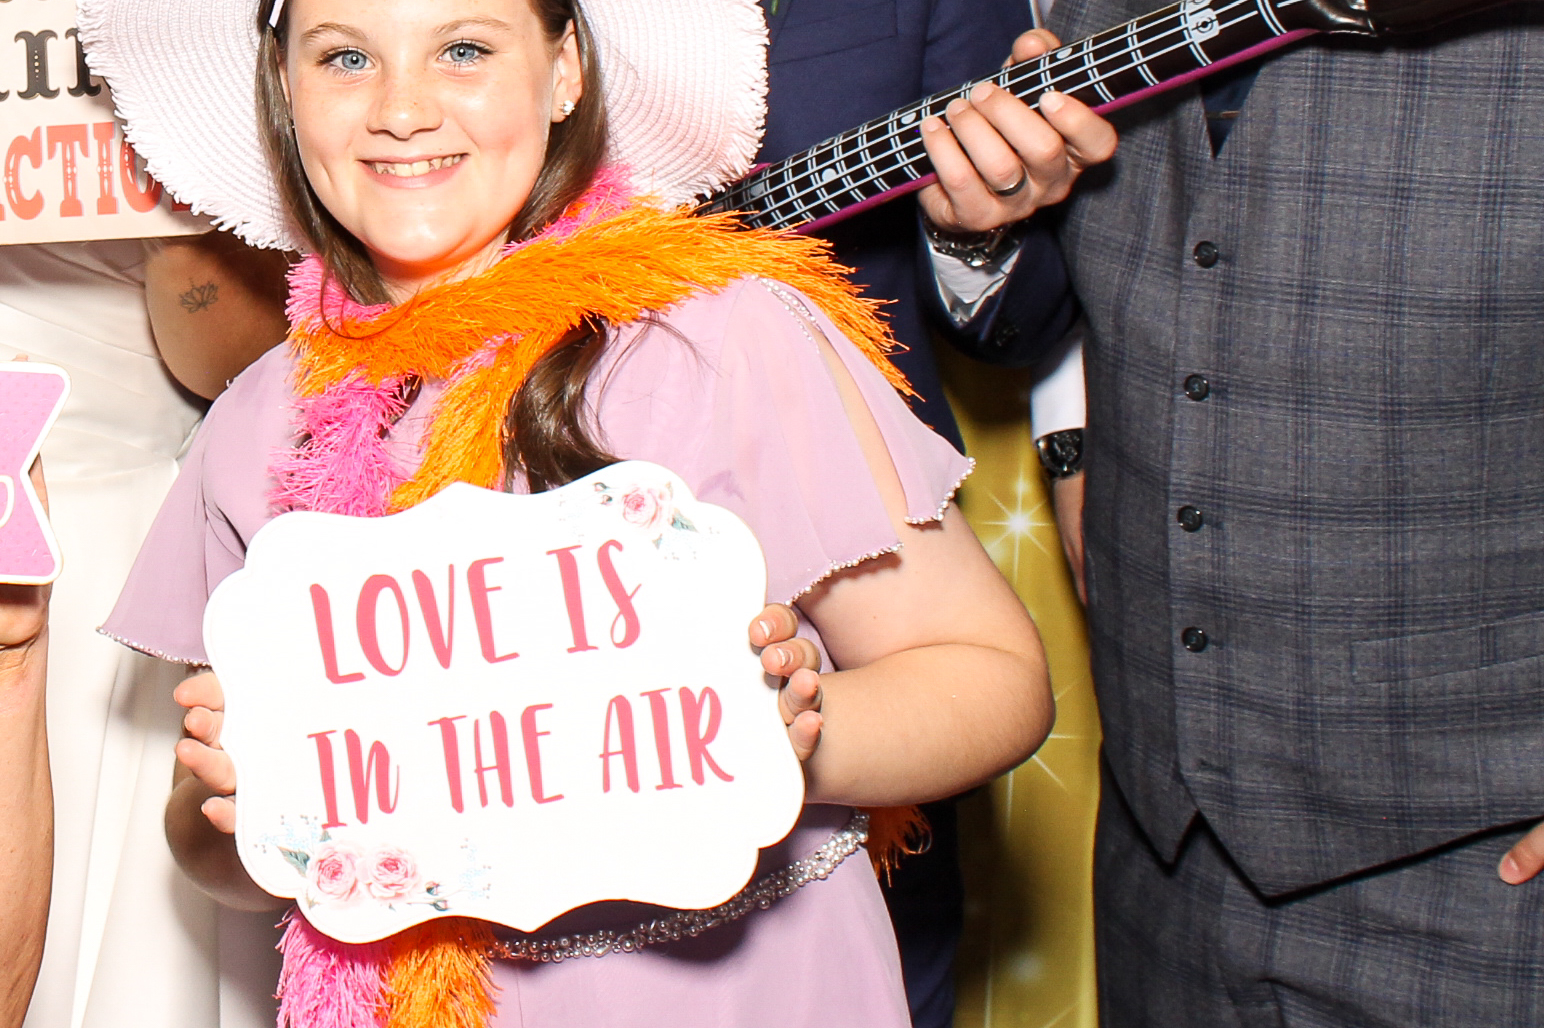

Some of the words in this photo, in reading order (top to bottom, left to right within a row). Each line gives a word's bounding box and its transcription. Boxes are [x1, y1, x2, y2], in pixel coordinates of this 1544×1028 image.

[309, 556, 520, 685] LOVE
[546, 539, 643, 654] IS
[428, 703, 564, 814] THE
[599, 686, 735, 795] AIR
